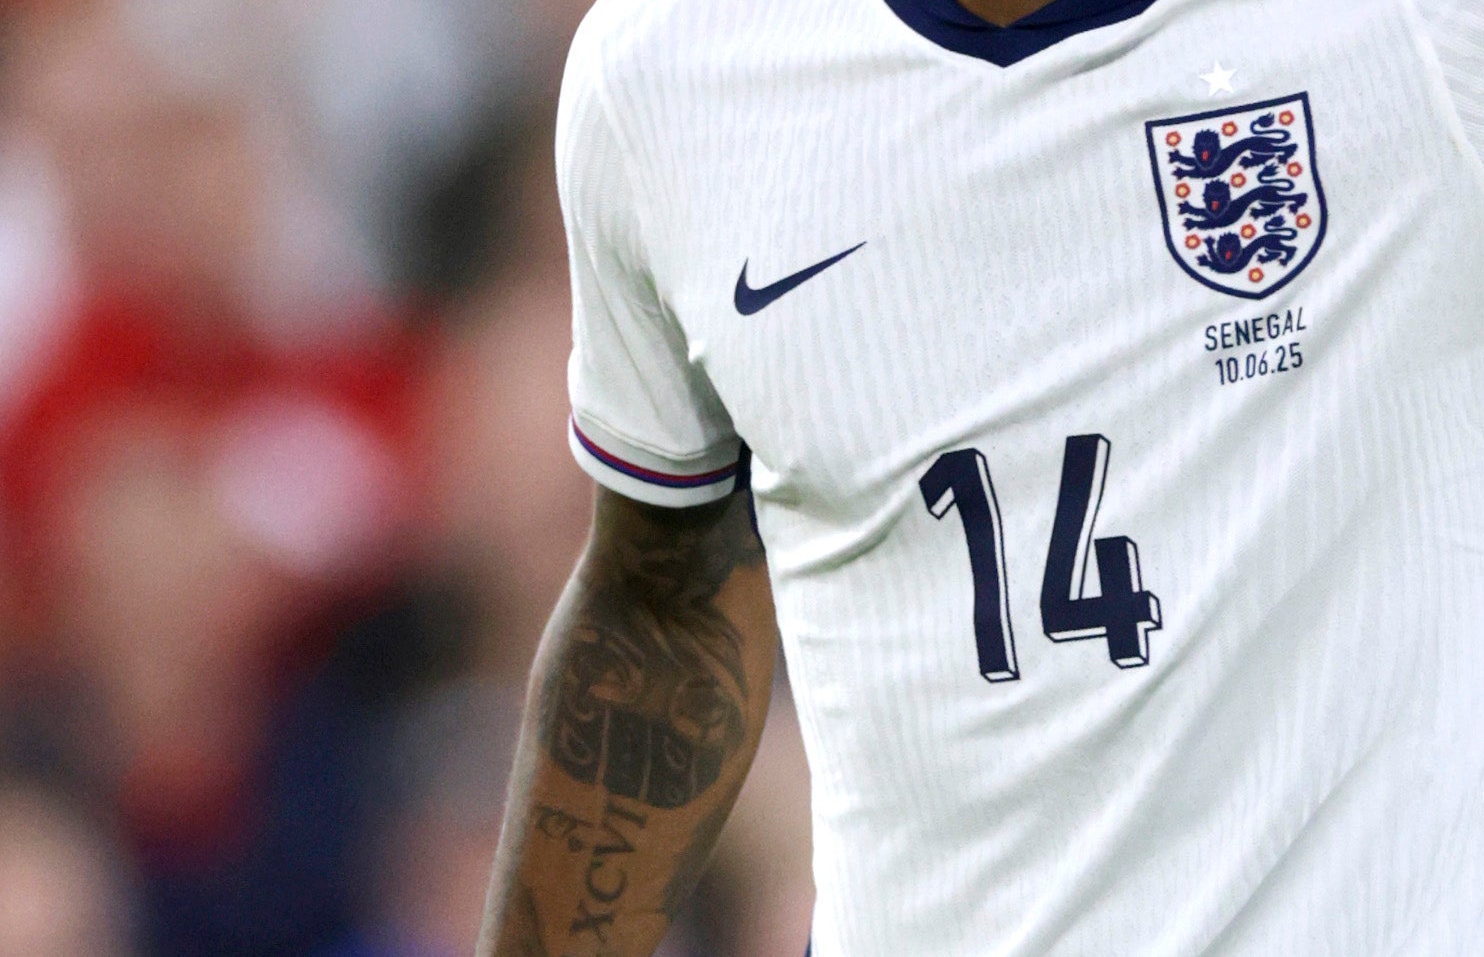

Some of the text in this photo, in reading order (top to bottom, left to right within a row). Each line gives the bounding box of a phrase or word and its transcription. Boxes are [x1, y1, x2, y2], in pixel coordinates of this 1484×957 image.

[1205, 307, 1306, 351] SENEGAL
[1215, 343, 1303, 385] 10.06.25
[919, 433, 1162, 683] 14
